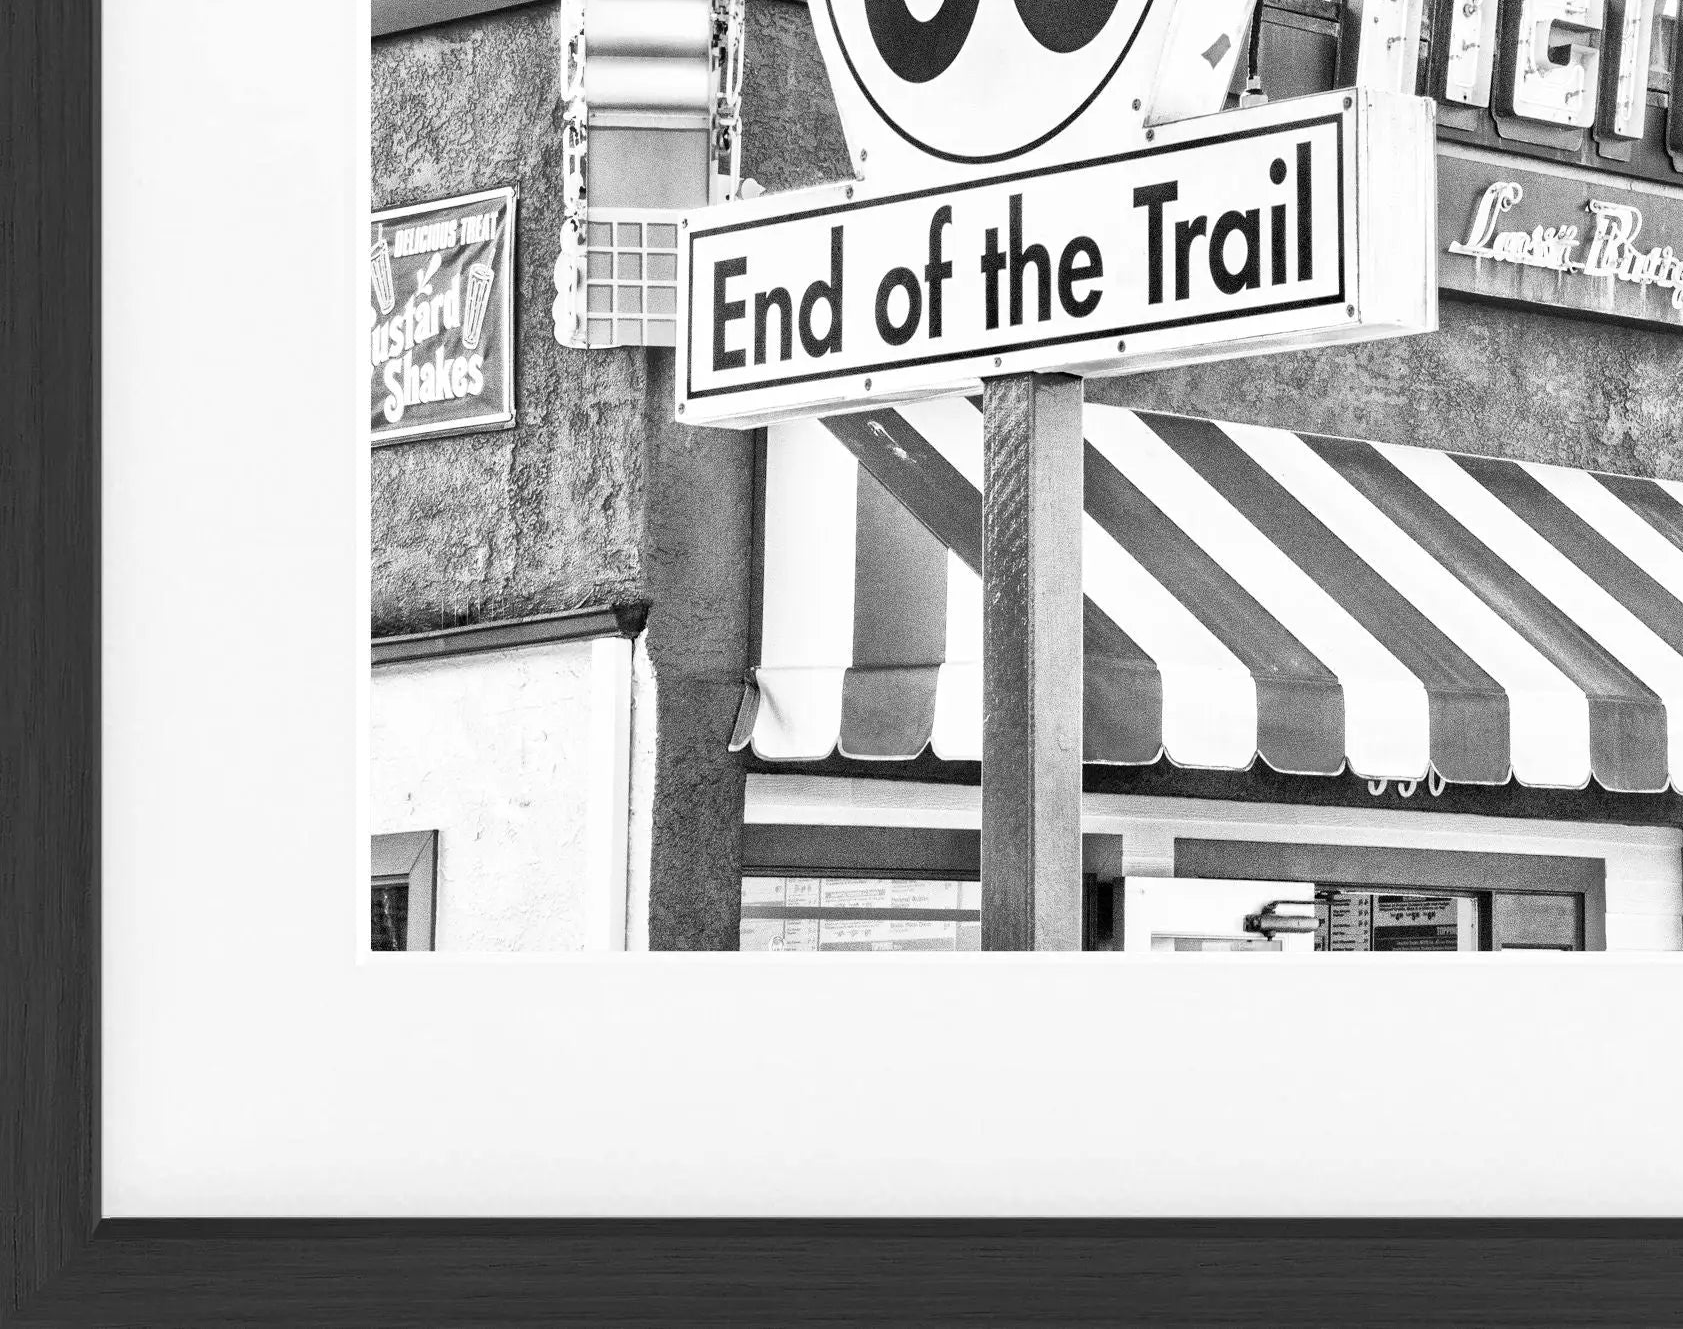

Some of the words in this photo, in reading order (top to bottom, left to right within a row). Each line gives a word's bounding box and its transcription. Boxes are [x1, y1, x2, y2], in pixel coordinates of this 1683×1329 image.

[711, 225, 844, 373] End
[874, 204, 953, 346] of
[980, 193, 1104, 329] the
[1133, 141, 1314, 305] Trail
[371, 272, 461, 371] ustard
[384, 344, 484, 423] Shakes
